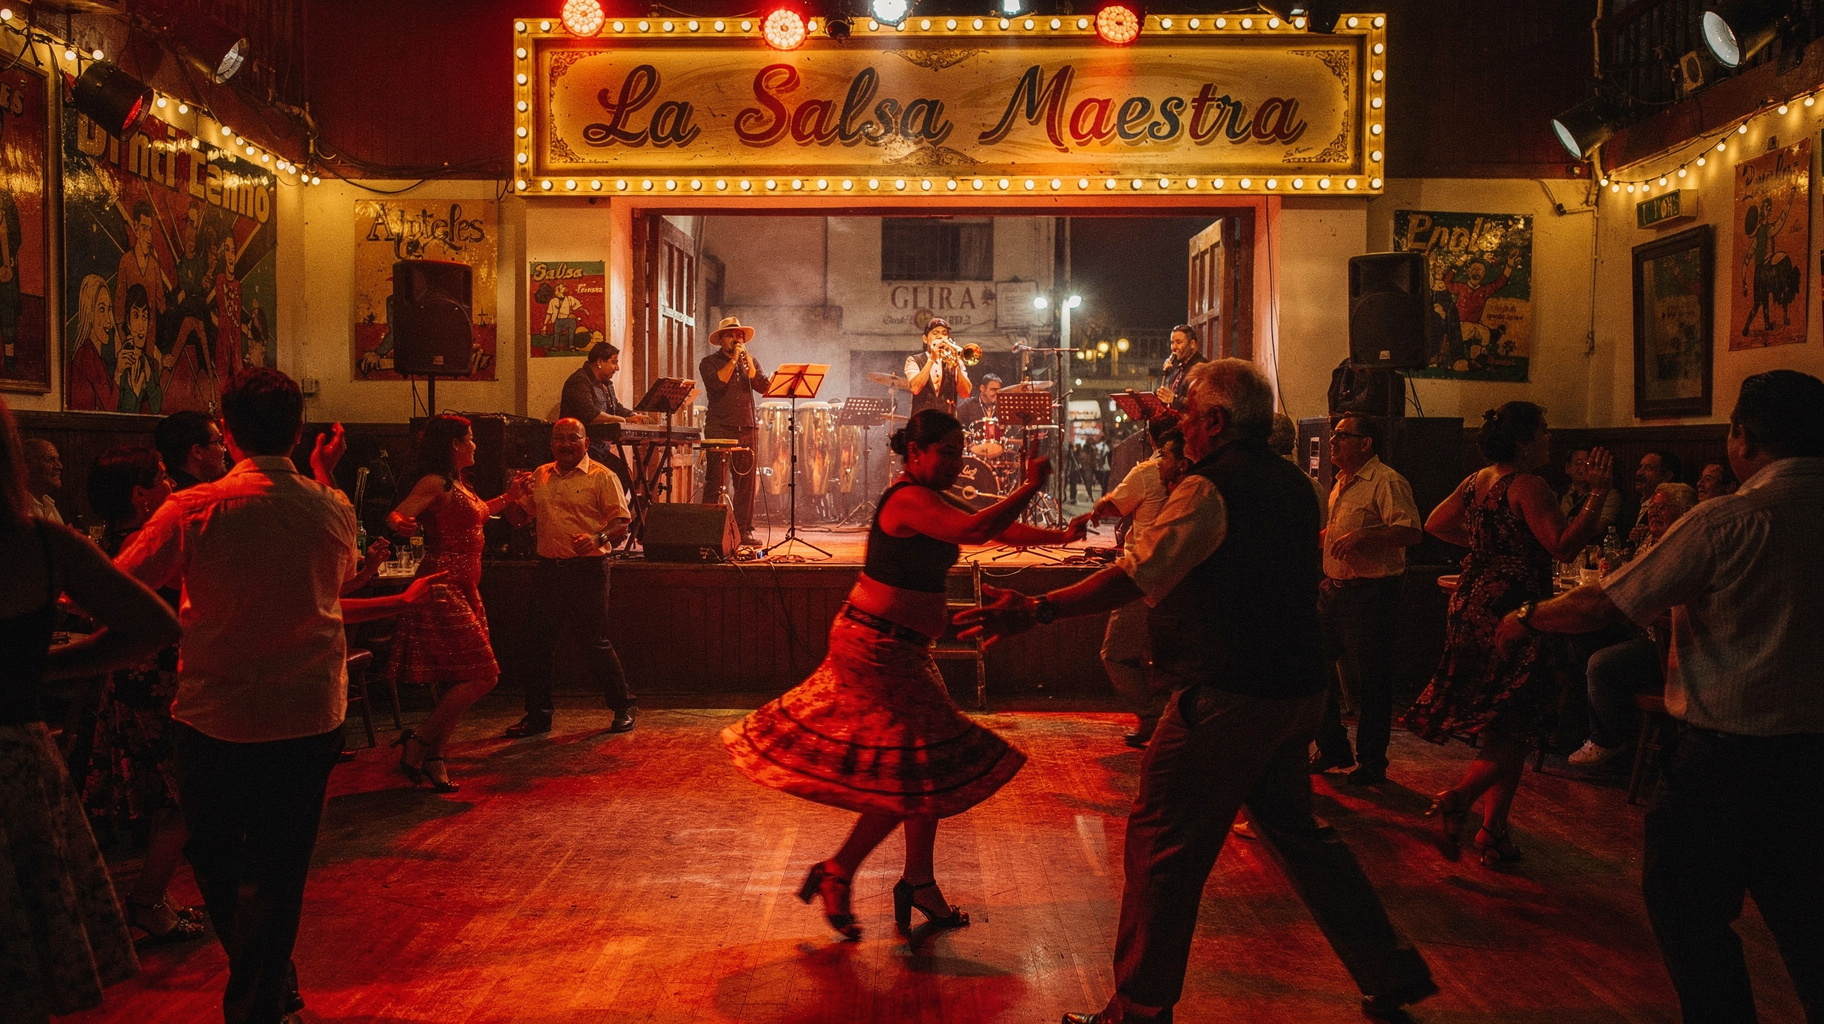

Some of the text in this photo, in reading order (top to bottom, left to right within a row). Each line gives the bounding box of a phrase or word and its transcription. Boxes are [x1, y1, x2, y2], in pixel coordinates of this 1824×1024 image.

[583, 64, 1306, 153] La Salsa Maestra
[533, 262, 583, 281] Salsa
